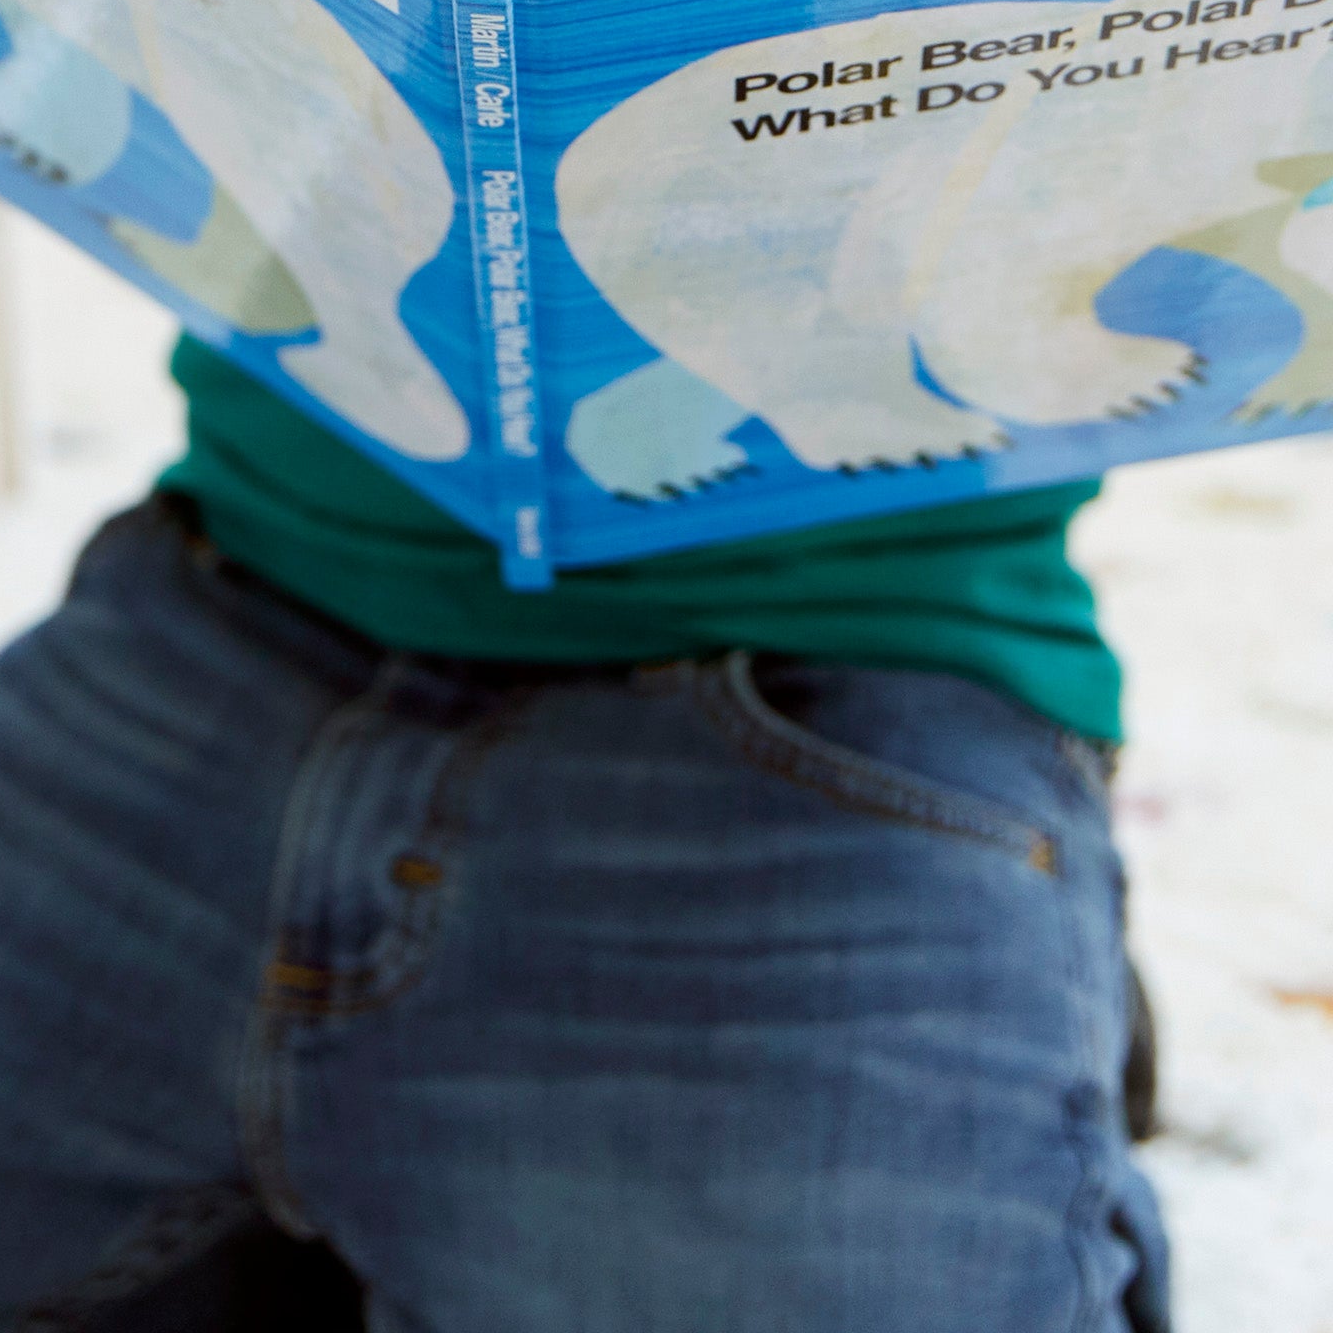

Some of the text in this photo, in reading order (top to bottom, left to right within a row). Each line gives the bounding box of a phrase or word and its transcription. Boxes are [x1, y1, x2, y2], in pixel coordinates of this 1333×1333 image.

[470, 13, 508, 68] Martin
[734, 54, 903, 102] Polar
[919, 26, 1076, 70] Bear,
[475, 83, 511, 128] Carle
[731, 94, 897, 142] What
[917, 81, 1005, 112] Do
[1027, 57, 1144, 90] You
[482, 170, 517, 209] Polar
[488, 250, 524, 288] Polar
